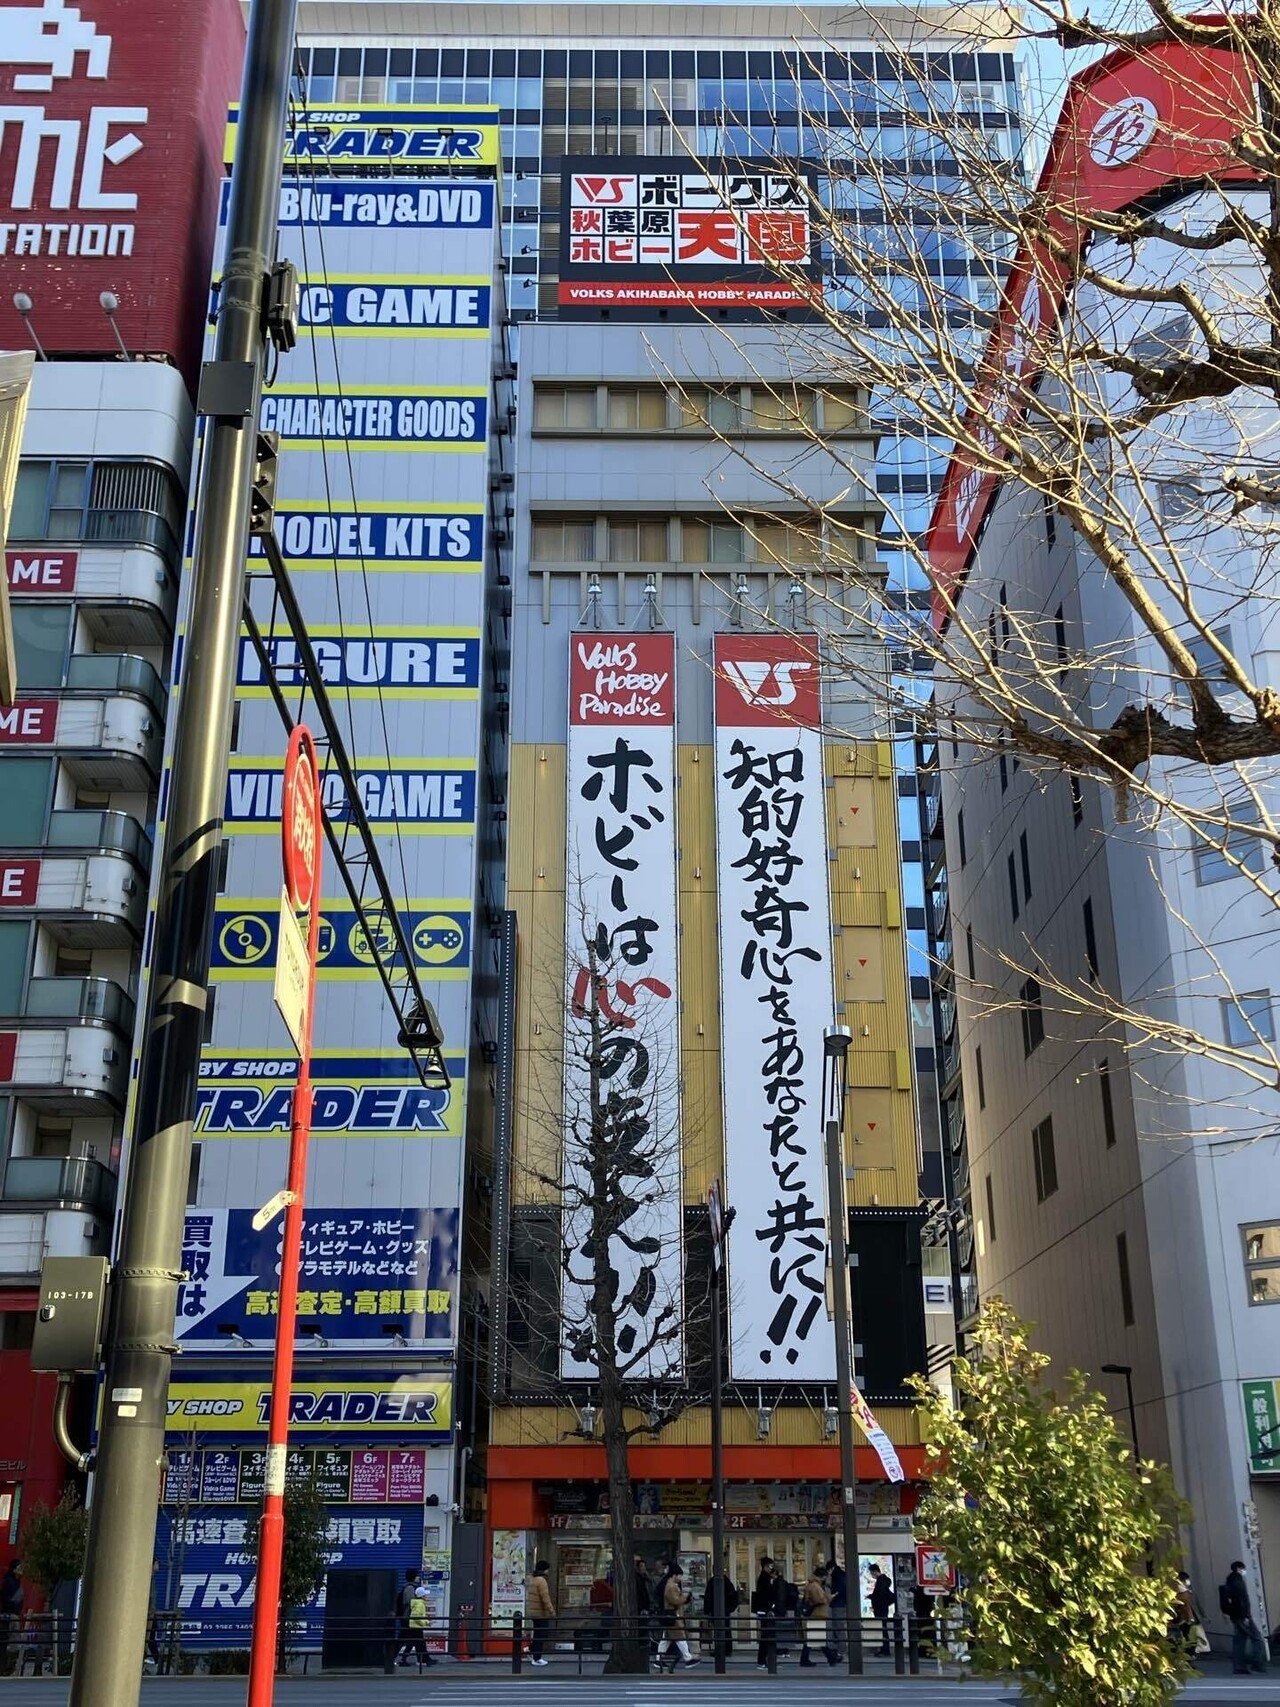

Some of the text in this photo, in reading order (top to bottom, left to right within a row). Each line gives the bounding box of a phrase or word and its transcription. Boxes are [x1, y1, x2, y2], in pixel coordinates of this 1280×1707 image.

[310, 113, 361, 122] SHOP
[642, 176, 807, 205] ボークス
[572, 210, 670, 233] 秋葉原
[572, 238, 670, 261] ホビー
[570, 289, 614, 299] VOLKS
[618, 289, 695, 299] AKIHABARA
[698, 290, 742, 299] HOBBY
[346, 287, 479, 324] GAME
[259, 398, 476, 438] CHARACTER GOODS
[385, 516, 471, 557] KITS
[7, 559, 64, 584] ME
[240, 640, 467, 684] FIGURE
[229, 774, 346, 817] VIO
[362, 775, 462, 818] GAME
[231, 1061, 297, 1076] SHOP
[300, 1220, 415, 1236] ィギュア・ホビー
[174, 1215, 214, 1318] 買取は
[183, 1400, 243, 1415] SHOP
[256, 1391, 438, 1424] TRADER
[214, 1453, 230, 1464] 2F
[252, 1453, 267, 1464] 3F
[289, 1453, 304, 1464] 4F
[325, 1453, 341, 1464] 5F
[363, 1453, 378, 1464] 6F
[400, 1453, 415, 1464] 7F
[731, 1515, 747, 1528] 2F
